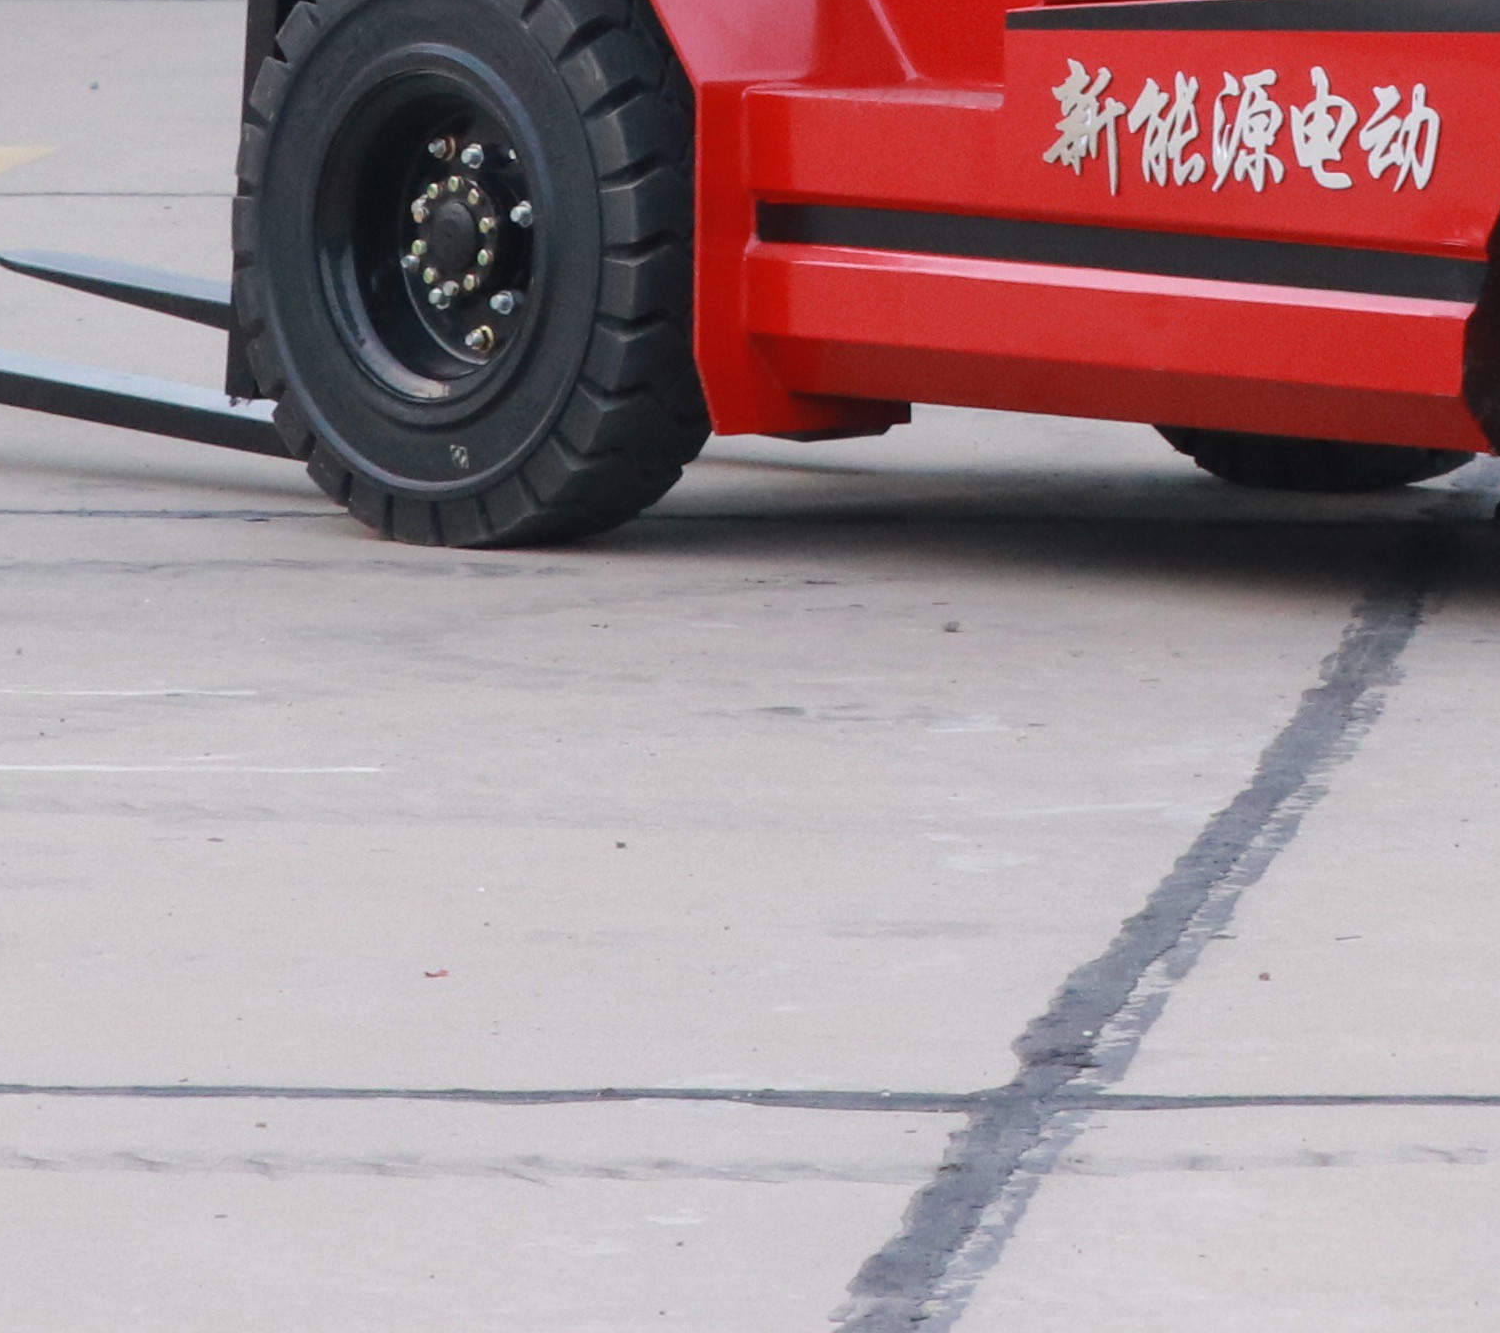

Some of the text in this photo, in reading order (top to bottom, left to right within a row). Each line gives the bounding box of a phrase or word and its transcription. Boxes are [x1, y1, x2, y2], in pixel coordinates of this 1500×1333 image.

[1041, 57, 1442, 197] 新能源电动
